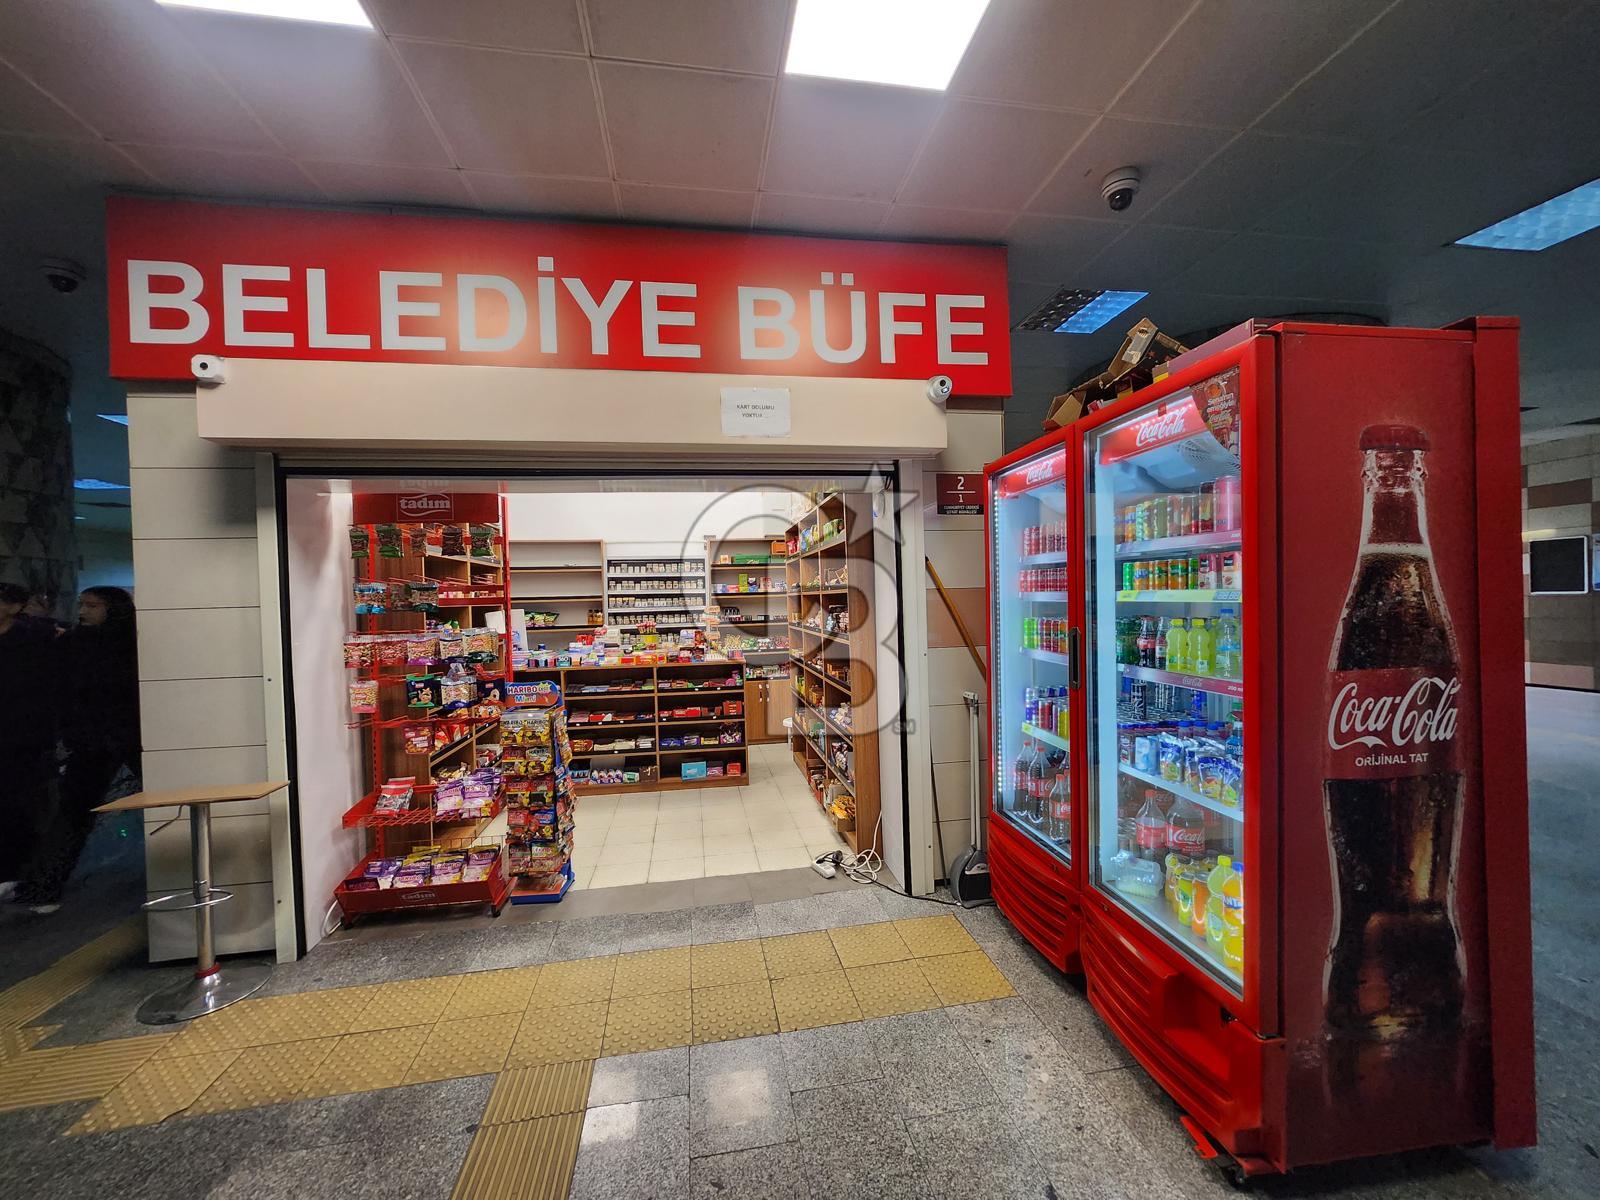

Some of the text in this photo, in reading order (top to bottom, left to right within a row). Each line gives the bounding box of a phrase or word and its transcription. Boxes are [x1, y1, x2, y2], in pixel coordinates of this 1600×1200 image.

[127, 256, 989, 366] BELEDİYE BÜFE
[957, 476, 965, 490] 2
[399, 498, 451, 509] tadım
[958, 494, 964, 503] 1
[507, 684, 538, 695] HARIBO
[1327, 676, 1462, 751] Coca-Cola
[1354, 752, 1430, 767] ORİJİNAL TAT
